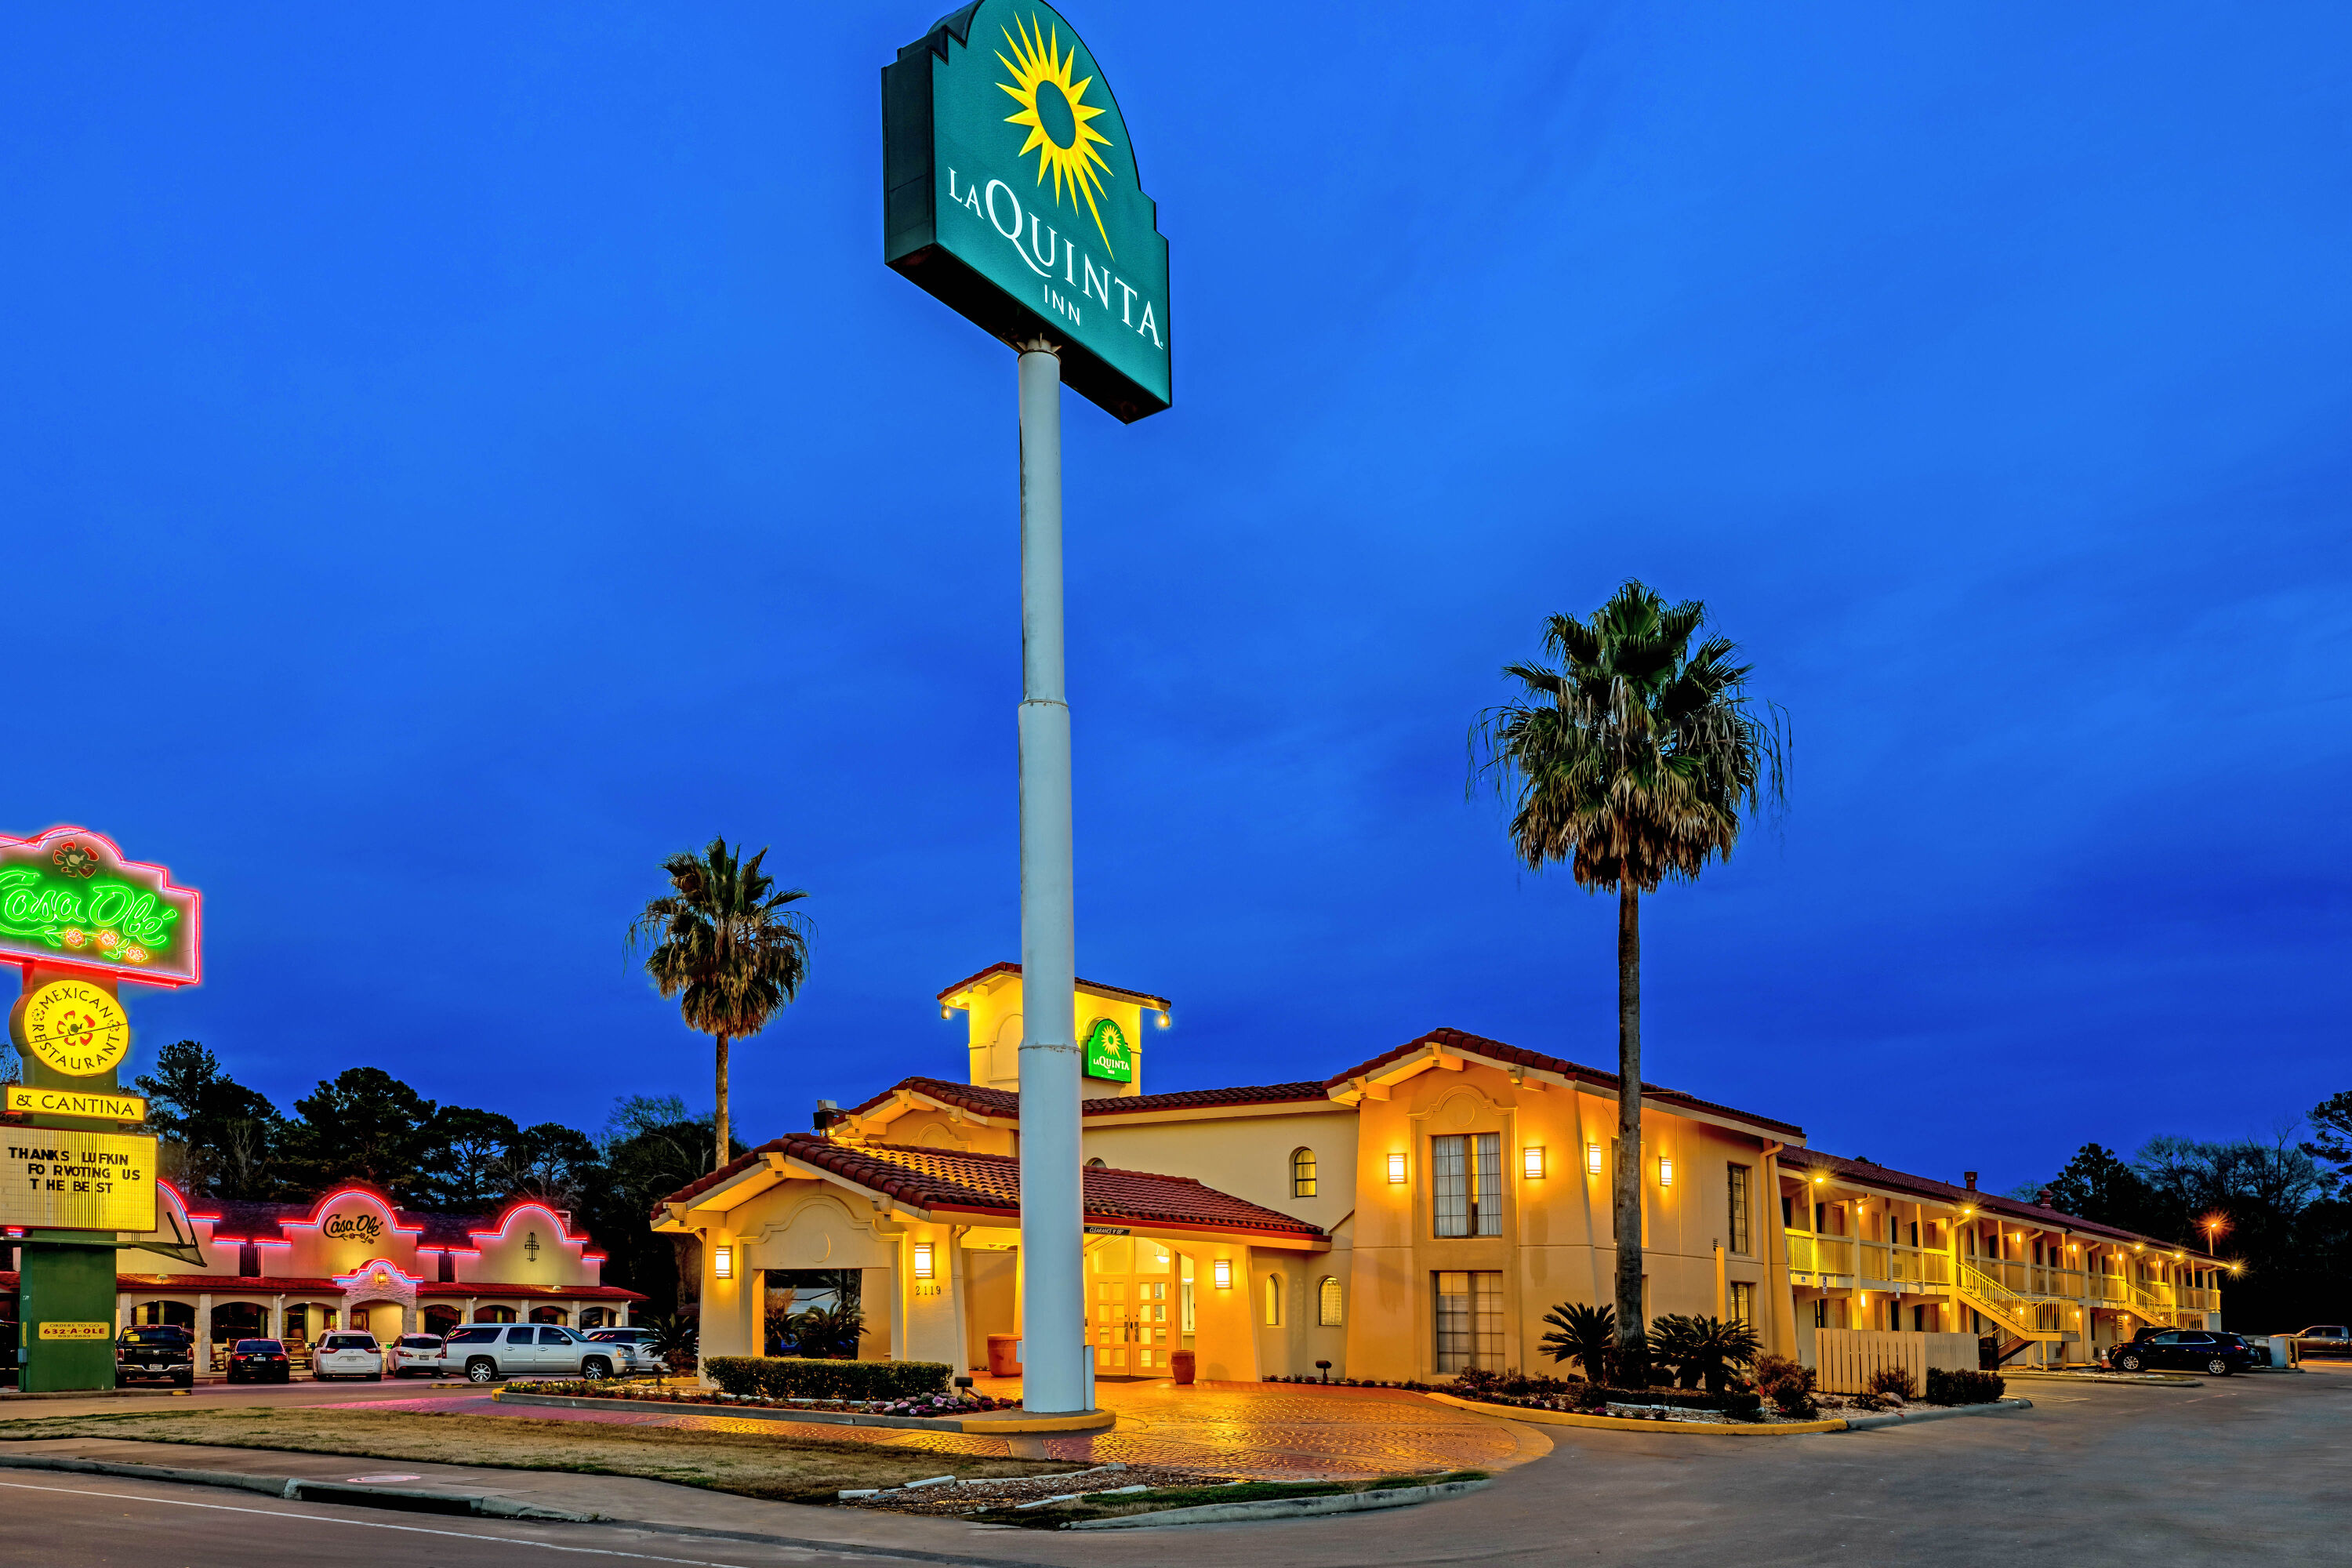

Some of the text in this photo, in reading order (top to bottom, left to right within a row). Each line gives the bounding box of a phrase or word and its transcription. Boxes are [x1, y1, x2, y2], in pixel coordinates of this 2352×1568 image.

[948, 166, 1163, 350] LA QUINTA
[1044, 284, 1081, 327] INN
[38, 987, 114, 1019] MEXICAN
[31, 1023, 120, 1070] RESTAURANT
[1099, 1056, 1129, 1070] QUINTA
[16, 1094, 135, 1116] & CANTINA
[8, 1146, 129, 1166] THANKS LUFKIN
[122, 1168, 140, 1181] US
[323, 1214, 384, 1238] Casa Olé
[916, 1286, 941, 1295] 2119
